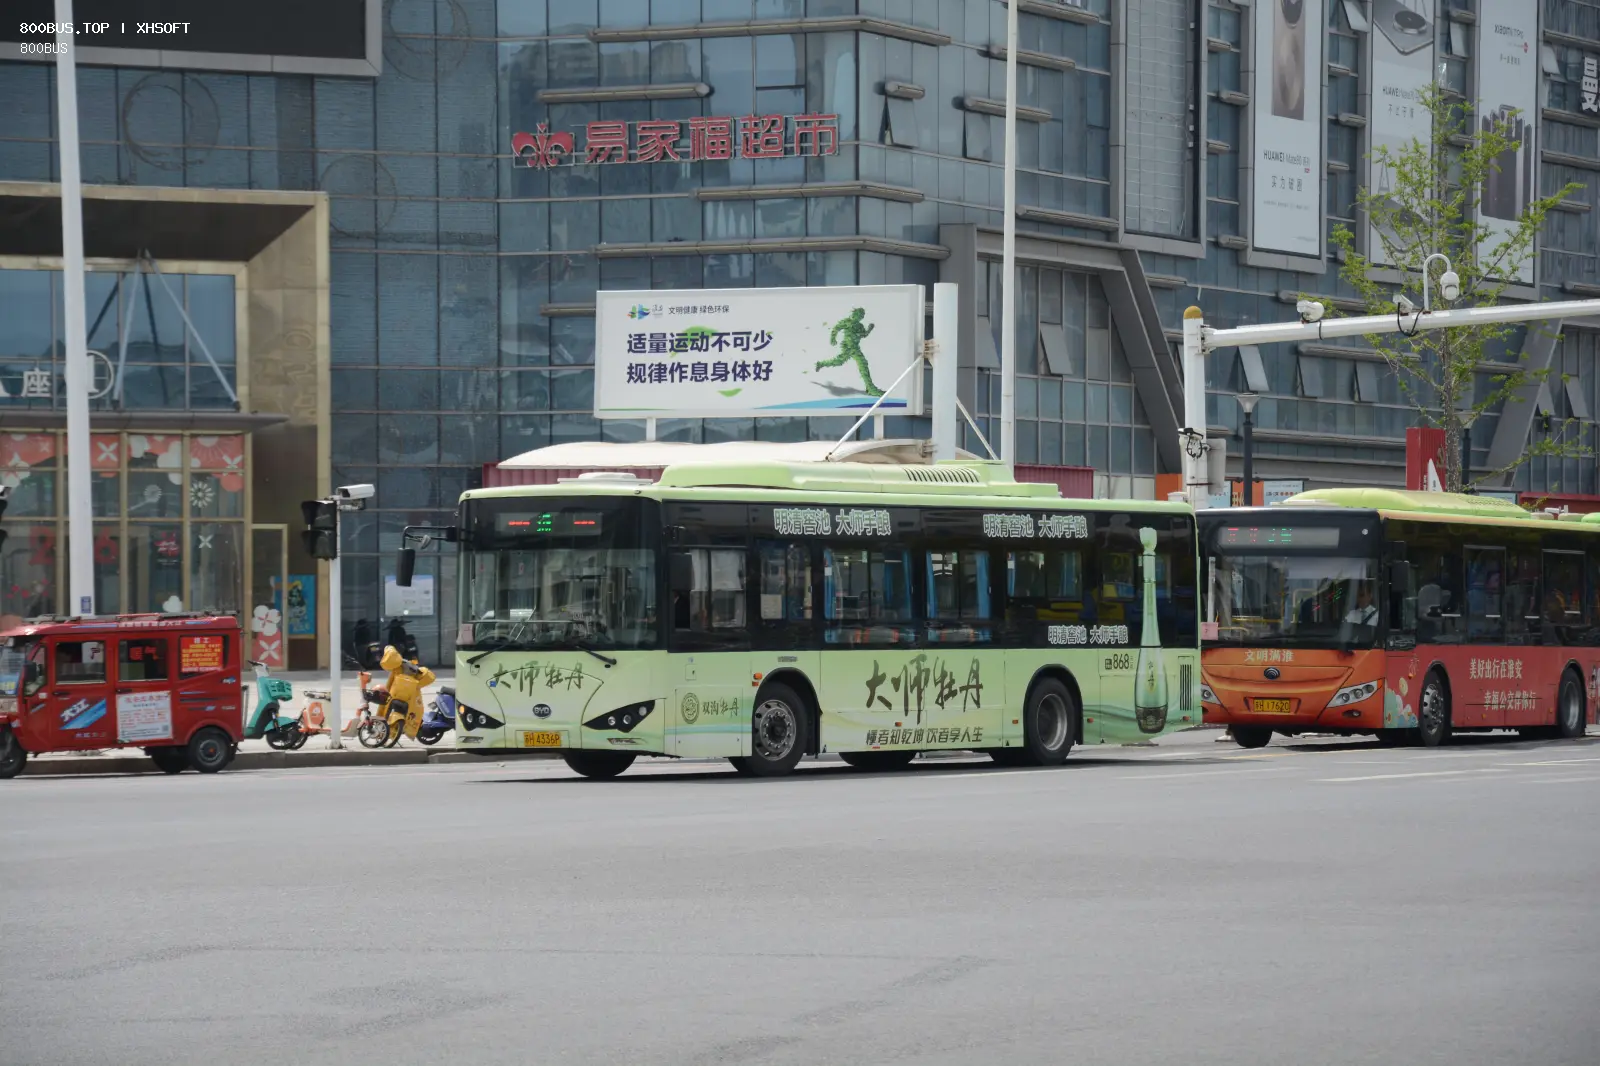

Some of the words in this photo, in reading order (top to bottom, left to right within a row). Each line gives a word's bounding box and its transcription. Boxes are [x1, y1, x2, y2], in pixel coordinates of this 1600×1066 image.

[585, 112, 840, 165] 易家福超市
[1263, 149, 1285, 163] HUAWEI
[668, 304, 698, 315] 文明健康
[626, 329, 774, 354] 适量运动不可少
[626, 360, 774, 384] 规律作息身体好
[773, 507, 832, 536] 明清窖池
[982, 512, 1035, 538] 明清窖池
[1112, 653, 1130, 670] 868
[1468, 658, 1523, 680] 美好出行在淮安
[866, 653, 984, 726] 大师牡丹
[533, 706, 550, 715] BYD
